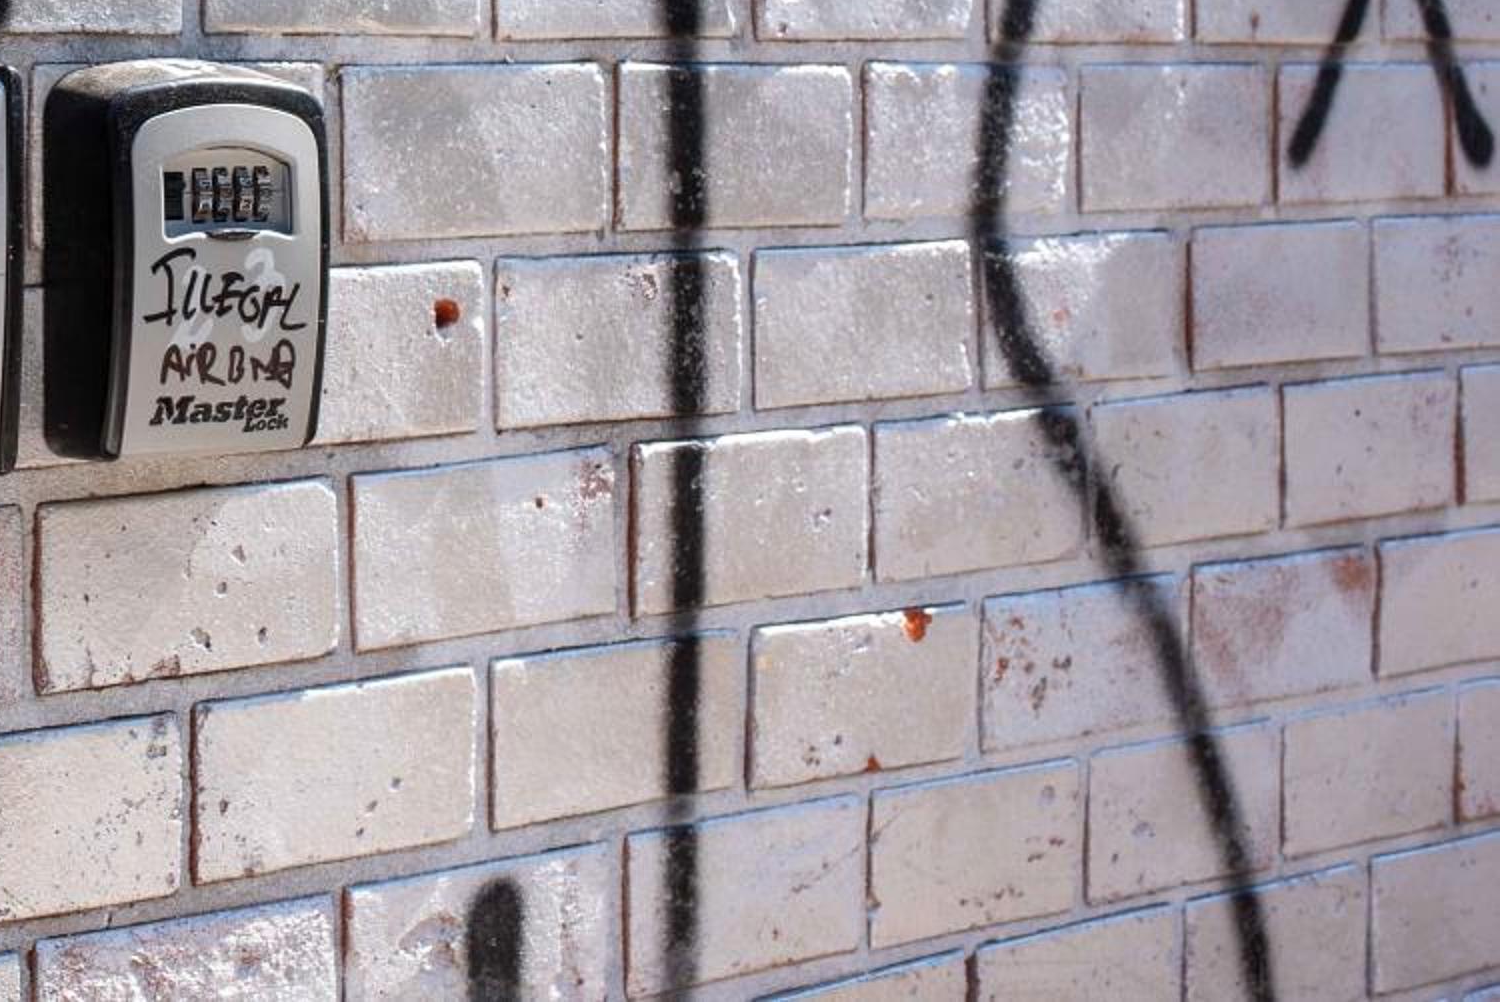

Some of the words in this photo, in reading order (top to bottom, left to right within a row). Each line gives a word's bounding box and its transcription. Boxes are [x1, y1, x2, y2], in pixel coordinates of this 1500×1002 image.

[143, 248, 307, 330] ILLEGAL
[149, 395, 287, 426] Master
[243, 413, 289, 432] Lock
